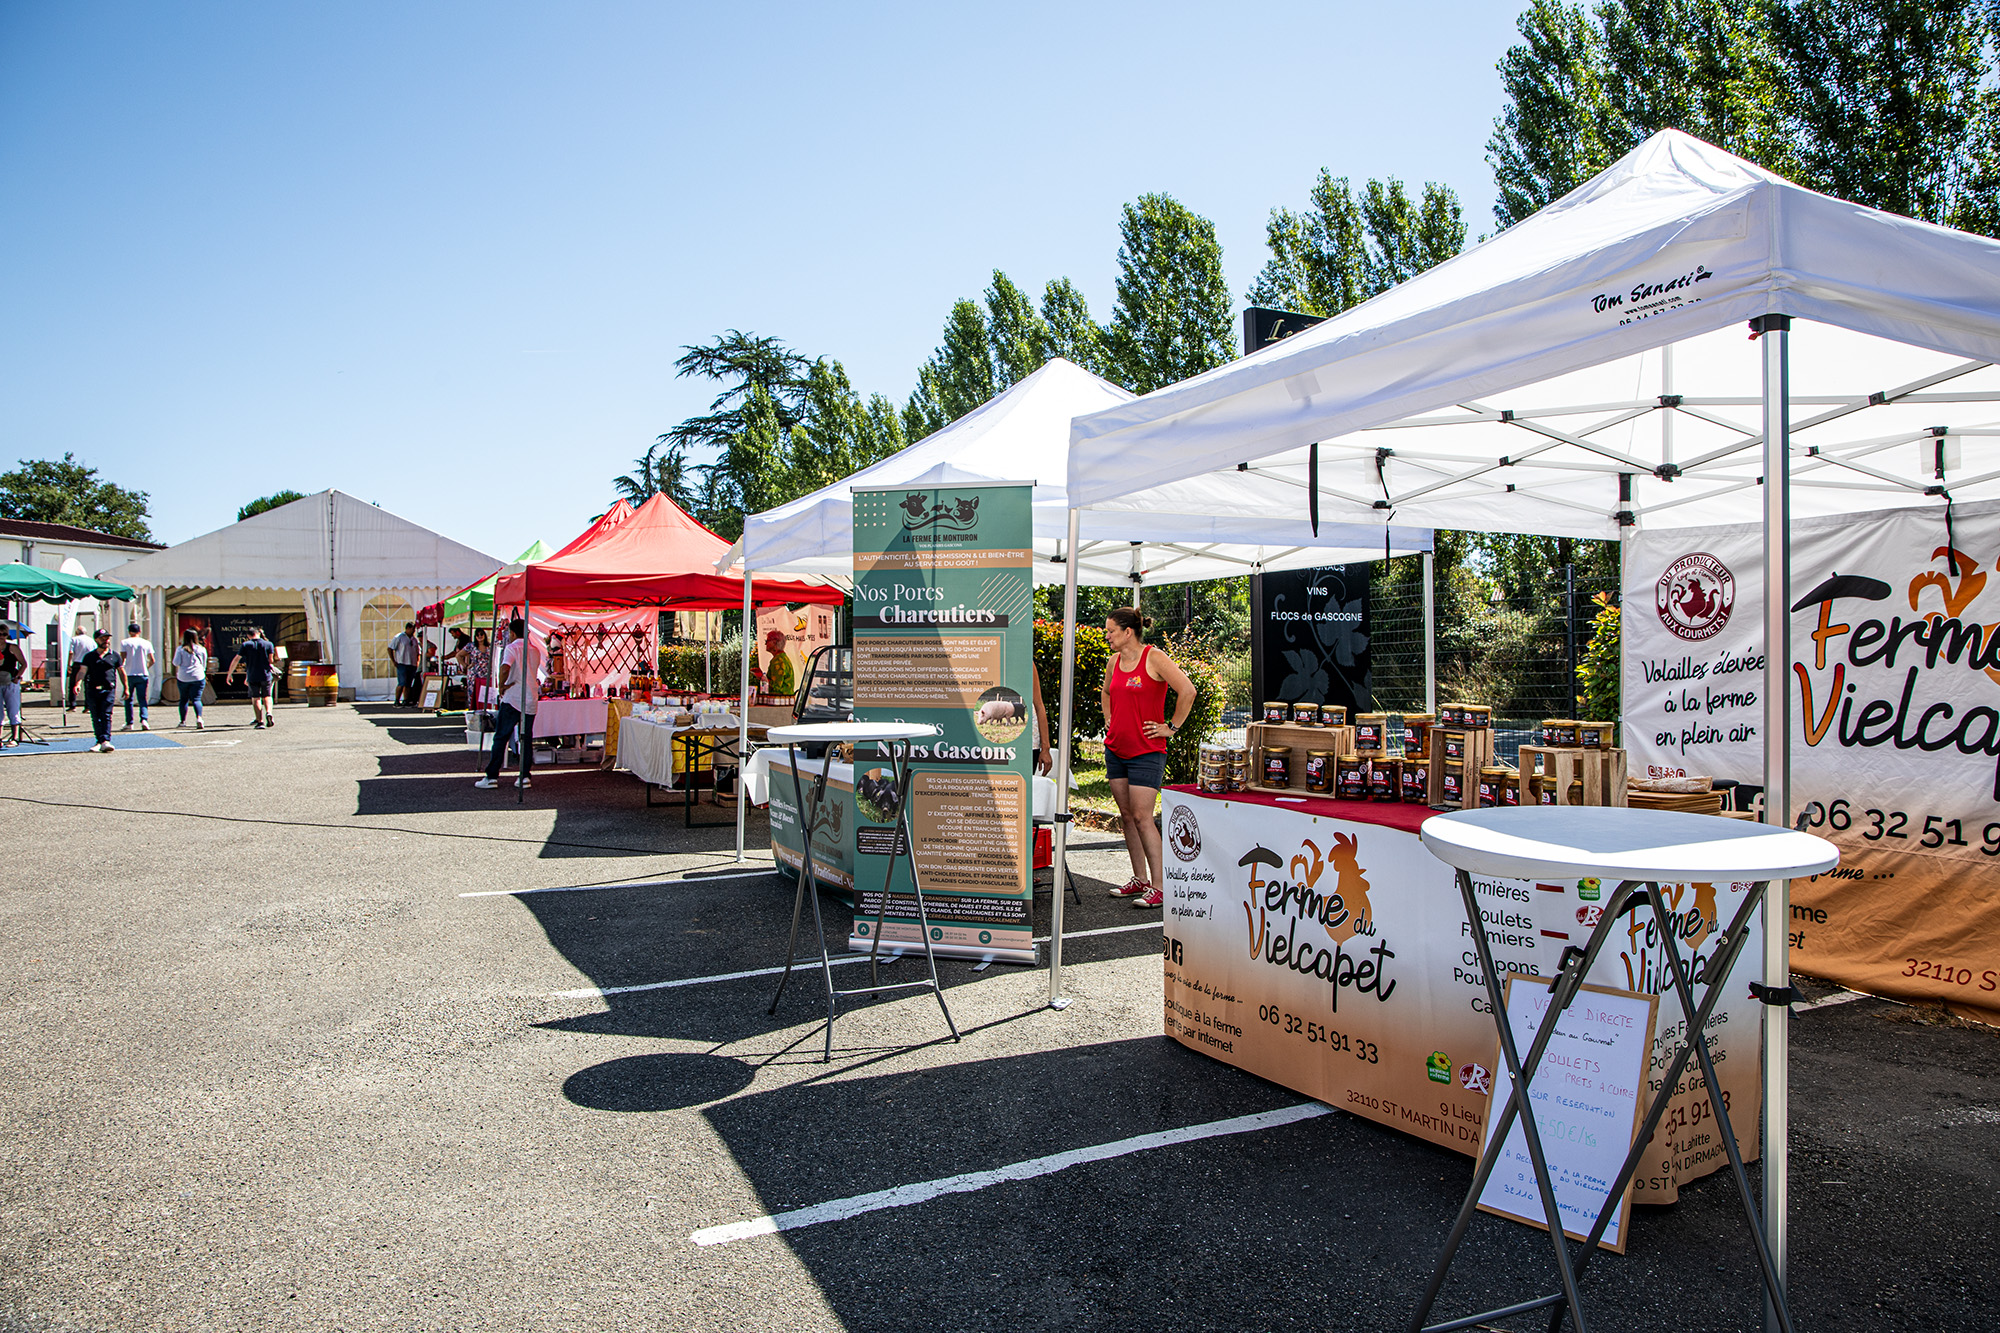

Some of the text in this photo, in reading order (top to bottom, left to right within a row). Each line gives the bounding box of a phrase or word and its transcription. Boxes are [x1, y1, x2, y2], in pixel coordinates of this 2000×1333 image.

[1591, 294, 1623, 313] Tom
[912, 535, 932, 543] FERME
[943, 534, 978, 542] MONTURON
[1661, 572, 1673, 586] DU
[1674, 556, 1731, 584] PRODUCTEUR
[855, 584, 944, 602] Nos Porcs
[1306, 587, 1328, 596] VINS
[879, 604, 996, 624] Charcutiers
[1271, 611, 1363, 622] FLOCS de GASCOGNE
[1661, 613, 1678, 632] AUX
[1678, 616, 1725, 639] GOURMETS
[1642, 647, 1764, 683] Volailles élevée
[1682, 689, 1701, 712] la
[1706, 686, 1757, 714] ferme
[1656, 721, 1756, 756] en plein air
[1793, 662, 2000, 802] Vielca
[933, 741, 1016, 760] Gascons
[1810, 799, 1852, 831] 06
[1863, 809, 1908, 841] 32
[1920, 816, 1968, 849] 51
[1165, 867, 1215, 883] Volailles élevées
[1179, 886, 1186, 897] la
[1188, 886, 1207, 901] ferme
[1248, 862, 1376, 937] Ferme du
[1171, 907, 1178, 915] en
[1178, 904, 1194, 921] plein
[1195, 908, 1206, 918] air
[1478, 905, 1533, 929] oulets
[1243, 901, 1397, 1013] Vielcapet
[1462, 951, 1539, 976] Chpons
[1901, 958, 2000, 991] 32110 S
[1193, 980, 1203, 992] de
[1204, 983, 1211, 995] la
[1212, 986, 1235, 1003] ferme
[1194, 1010, 1201, 1023] à
[1203, 1012, 1211, 1026] la
[1213, 1016, 1242, 1037] ferme
[1258, 1004, 1379, 1064] 06 32 51 91 33
[1183, 1025, 1196, 1039] par
[1198, 1029, 1234, 1053] internet
[1565, 1072, 1592, 1088] PRETS
[1530, 1089, 1549, 1101] SUR
[1346, 1089, 1480, 1145] 32110 ST MARTIN D'A
[1440, 1102, 1448, 1116] 9
[1691, 1099, 1710, 1126] 91
